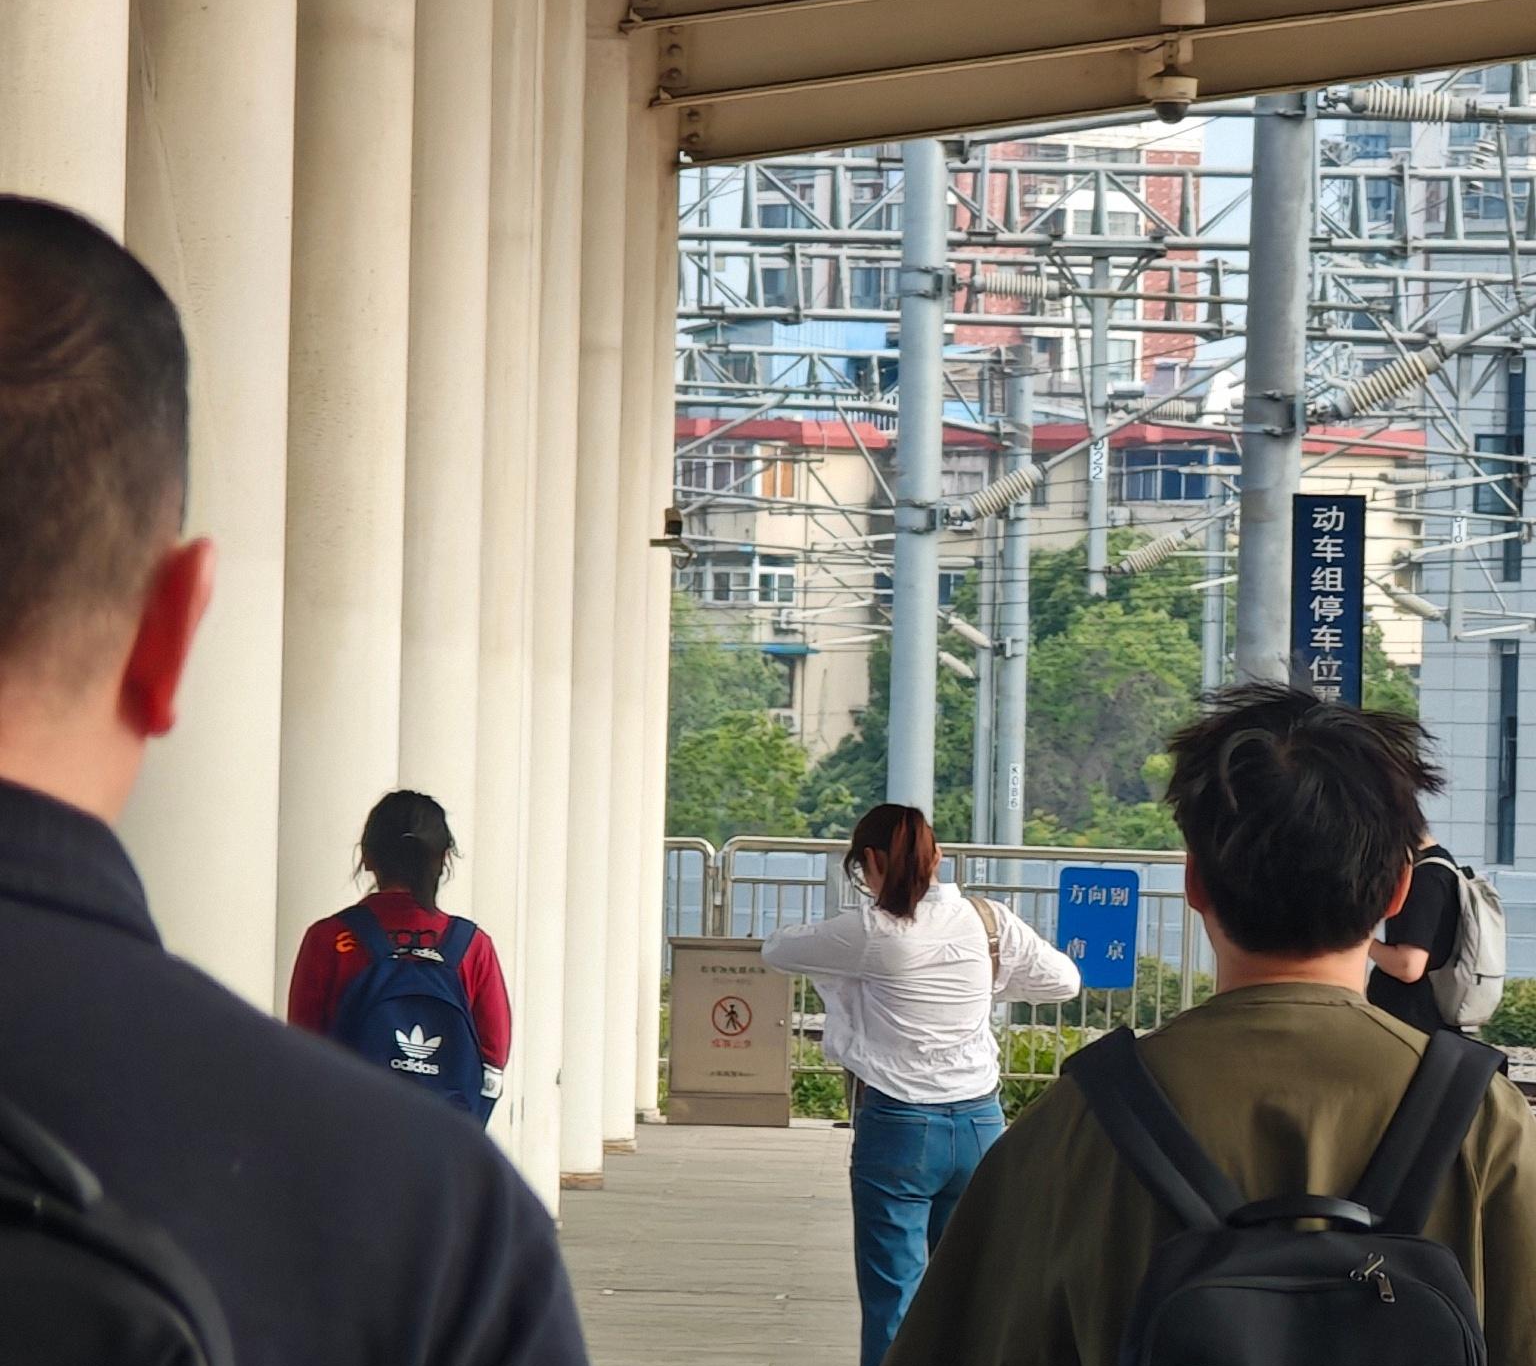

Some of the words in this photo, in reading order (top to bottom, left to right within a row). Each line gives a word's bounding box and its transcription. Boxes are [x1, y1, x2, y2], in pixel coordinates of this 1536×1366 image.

[1067, 884, 1129, 906] 方向别
[390, 1058, 440, 1075] adidas
